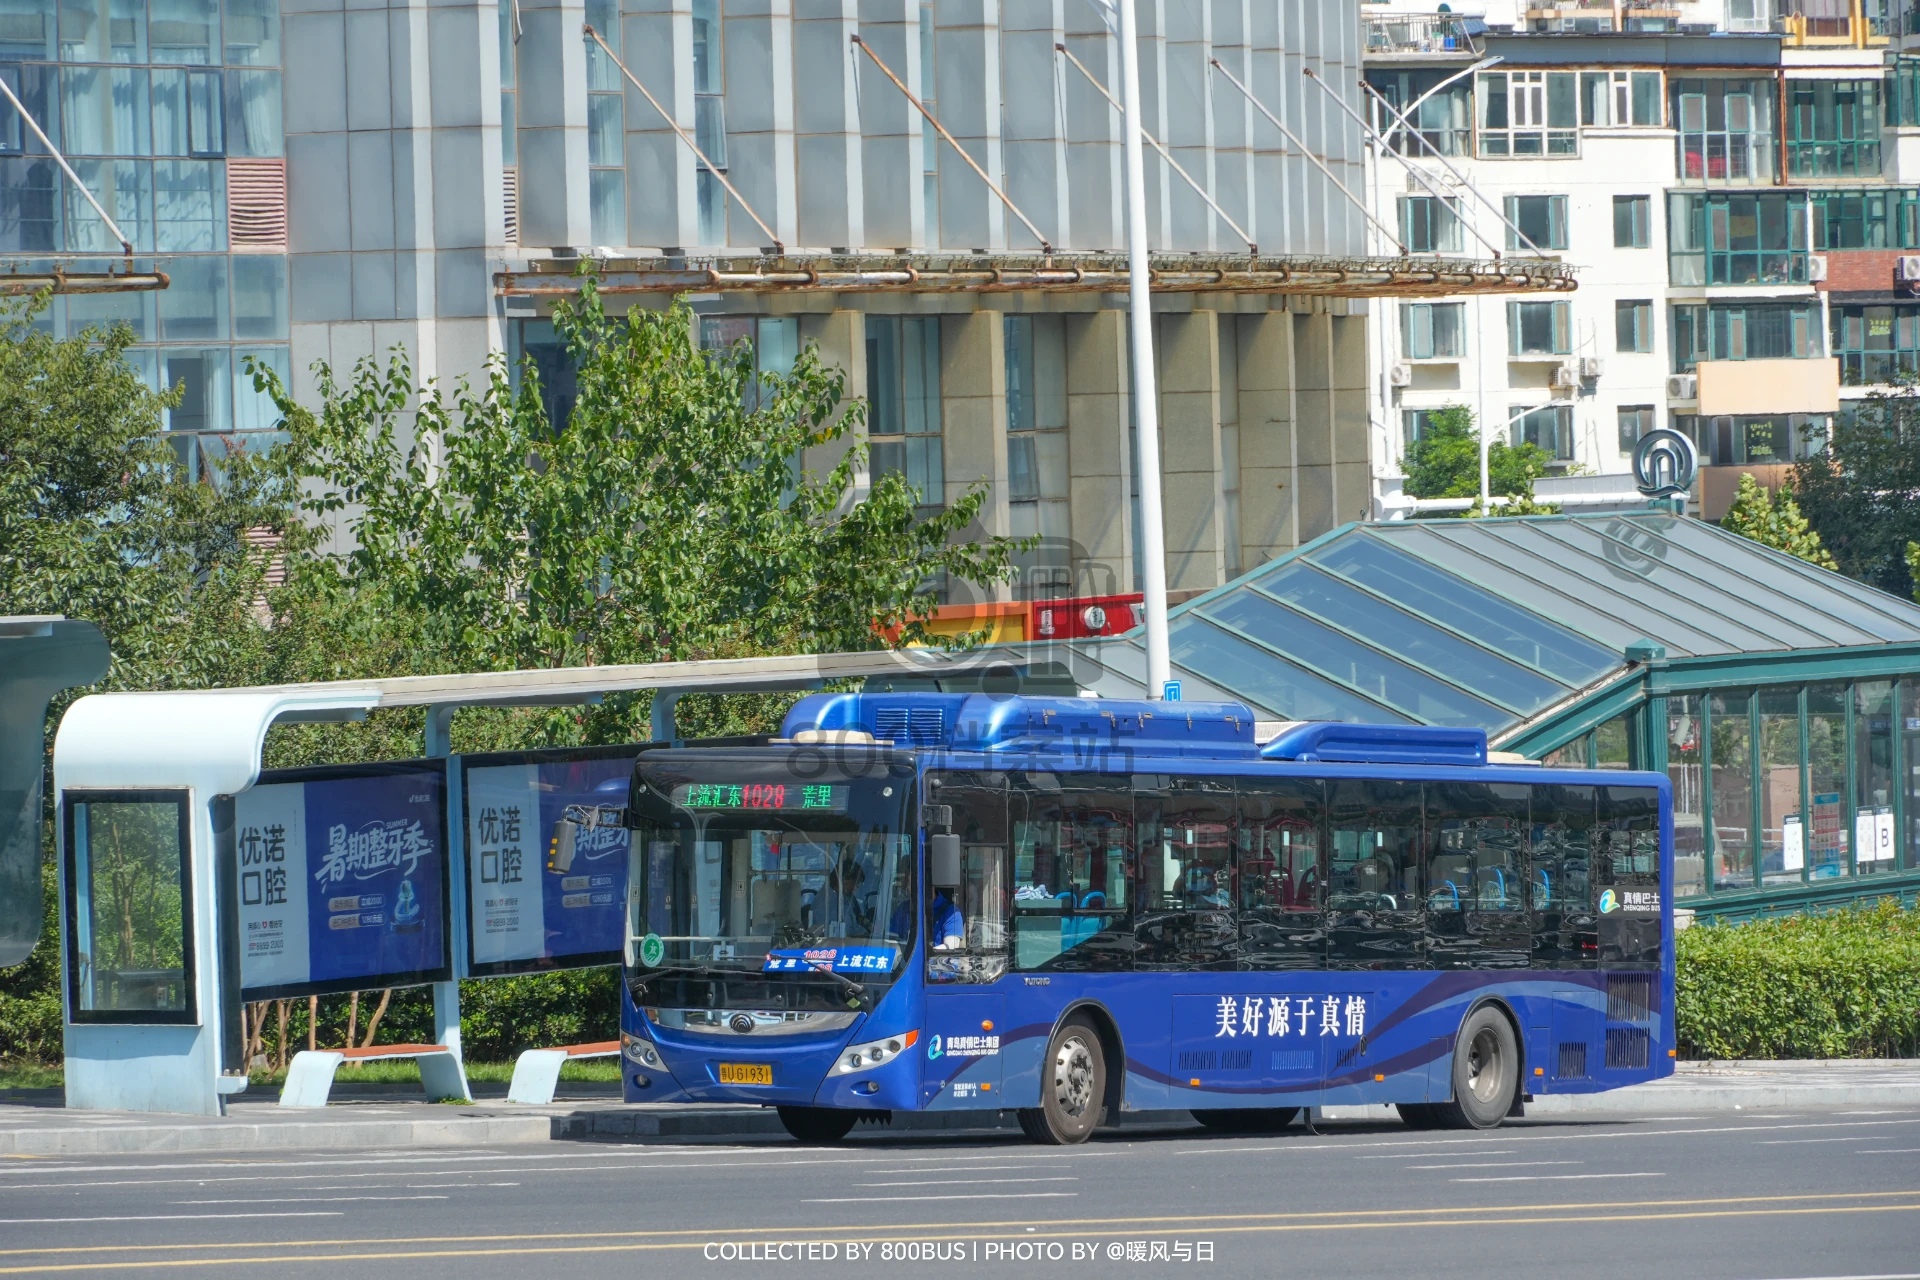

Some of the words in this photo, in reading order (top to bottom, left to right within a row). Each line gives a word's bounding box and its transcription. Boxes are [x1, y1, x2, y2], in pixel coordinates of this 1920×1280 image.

[682, 785, 742, 808] 上流汇东
[742, 784, 785, 808] 1028
[802, 785, 832, 808] 荒里
[386, 819, 408, 829] SUMMER
[478, 806, 520, 846] 优诺
[239, 824, 286, 866] 优诺
[1881, 828, 1889, 848] B
[314, 819, 433, 882] 暑期整牙季
[480, 846, 523, 884] 口腔
[241, 866, 288, 906] 口腔
[1623, 892, 1661, 904] 真情巴士
[804, 949, 836, 959] 1028
[837, 955, 889, 969] 上流汇东
[1023, 977, 1051, 986] YUTONG
[1215, 995, 1366, 1037] 美好源于真情
